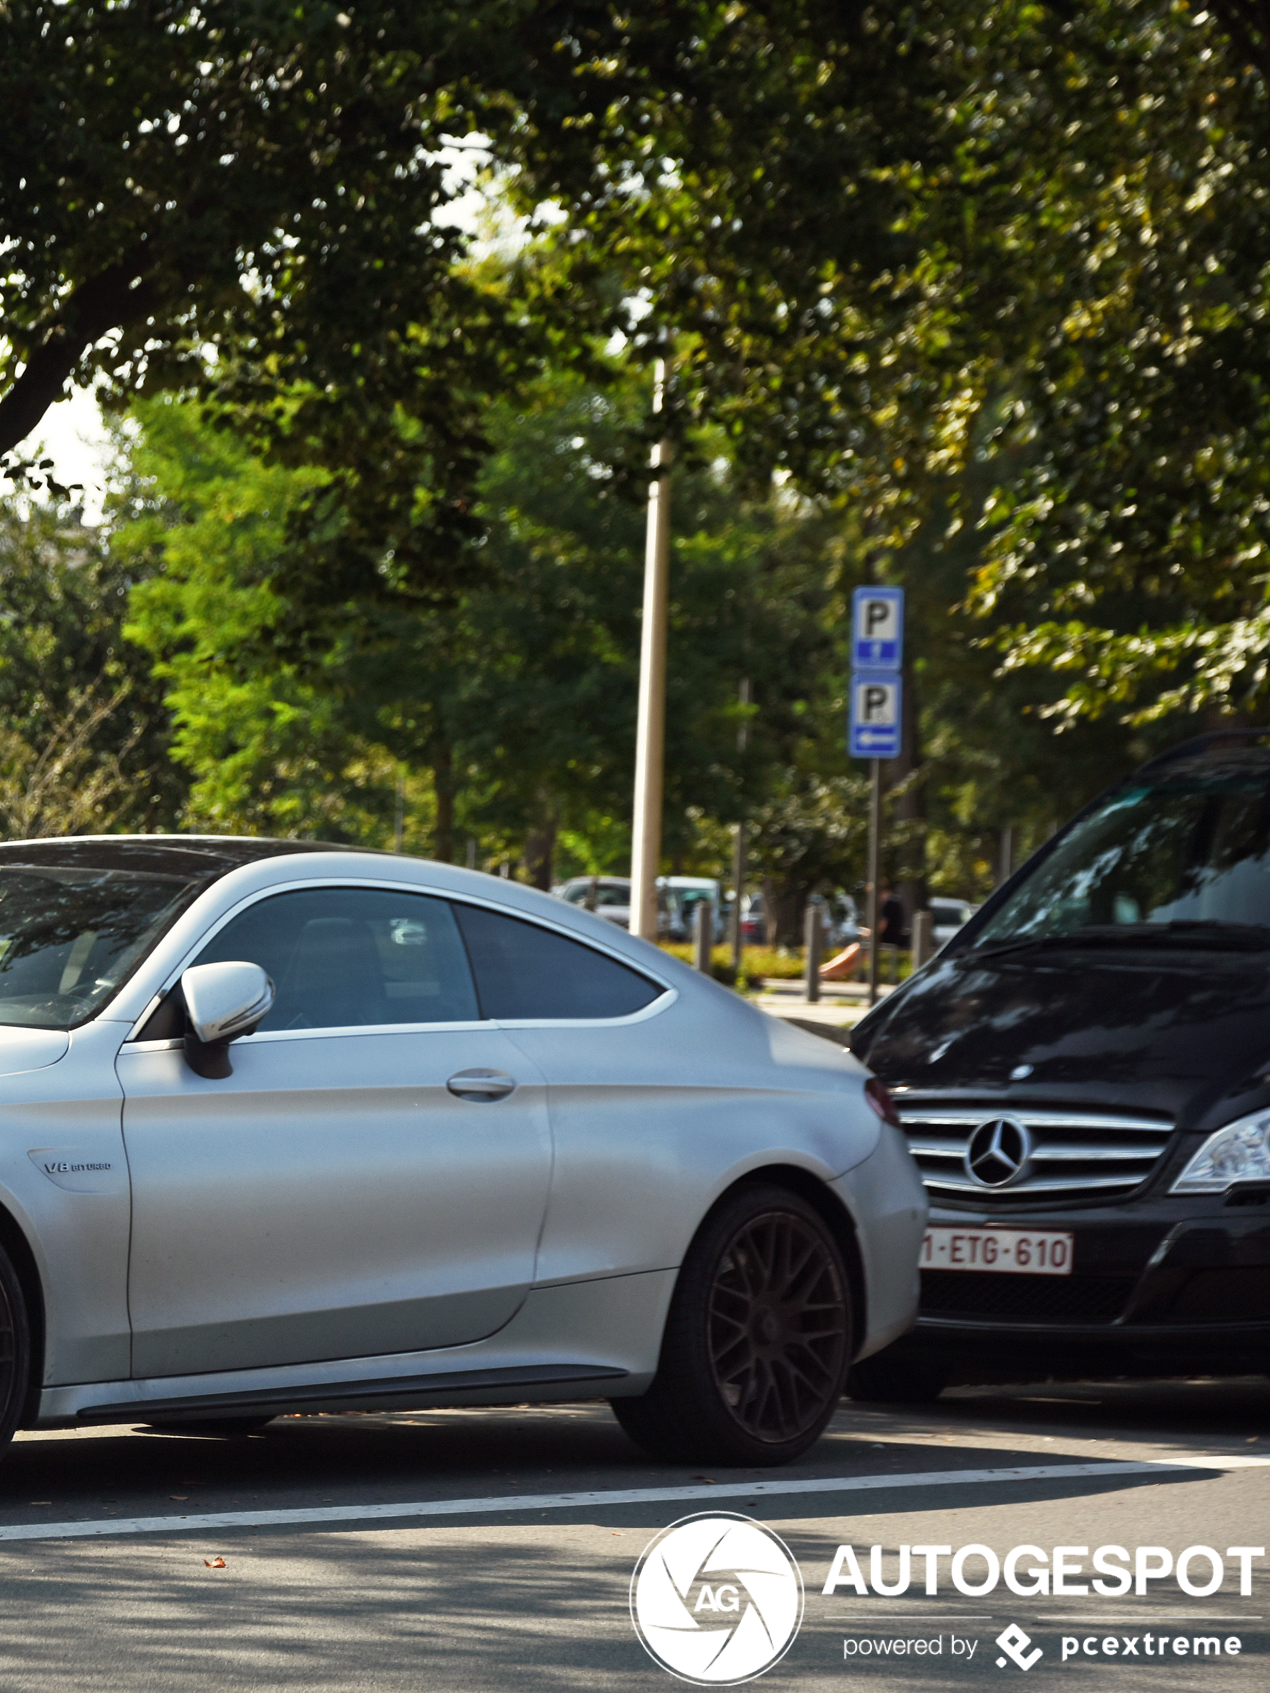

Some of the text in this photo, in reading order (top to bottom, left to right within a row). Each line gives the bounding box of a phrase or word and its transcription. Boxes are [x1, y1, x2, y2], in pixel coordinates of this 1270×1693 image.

[865, 601, 890, 637] P
[863, 687, 888, 721] P
[44, 1162, 69, 1174] V8
[923, 1233, 1068, 1268] 1-ETG-610
